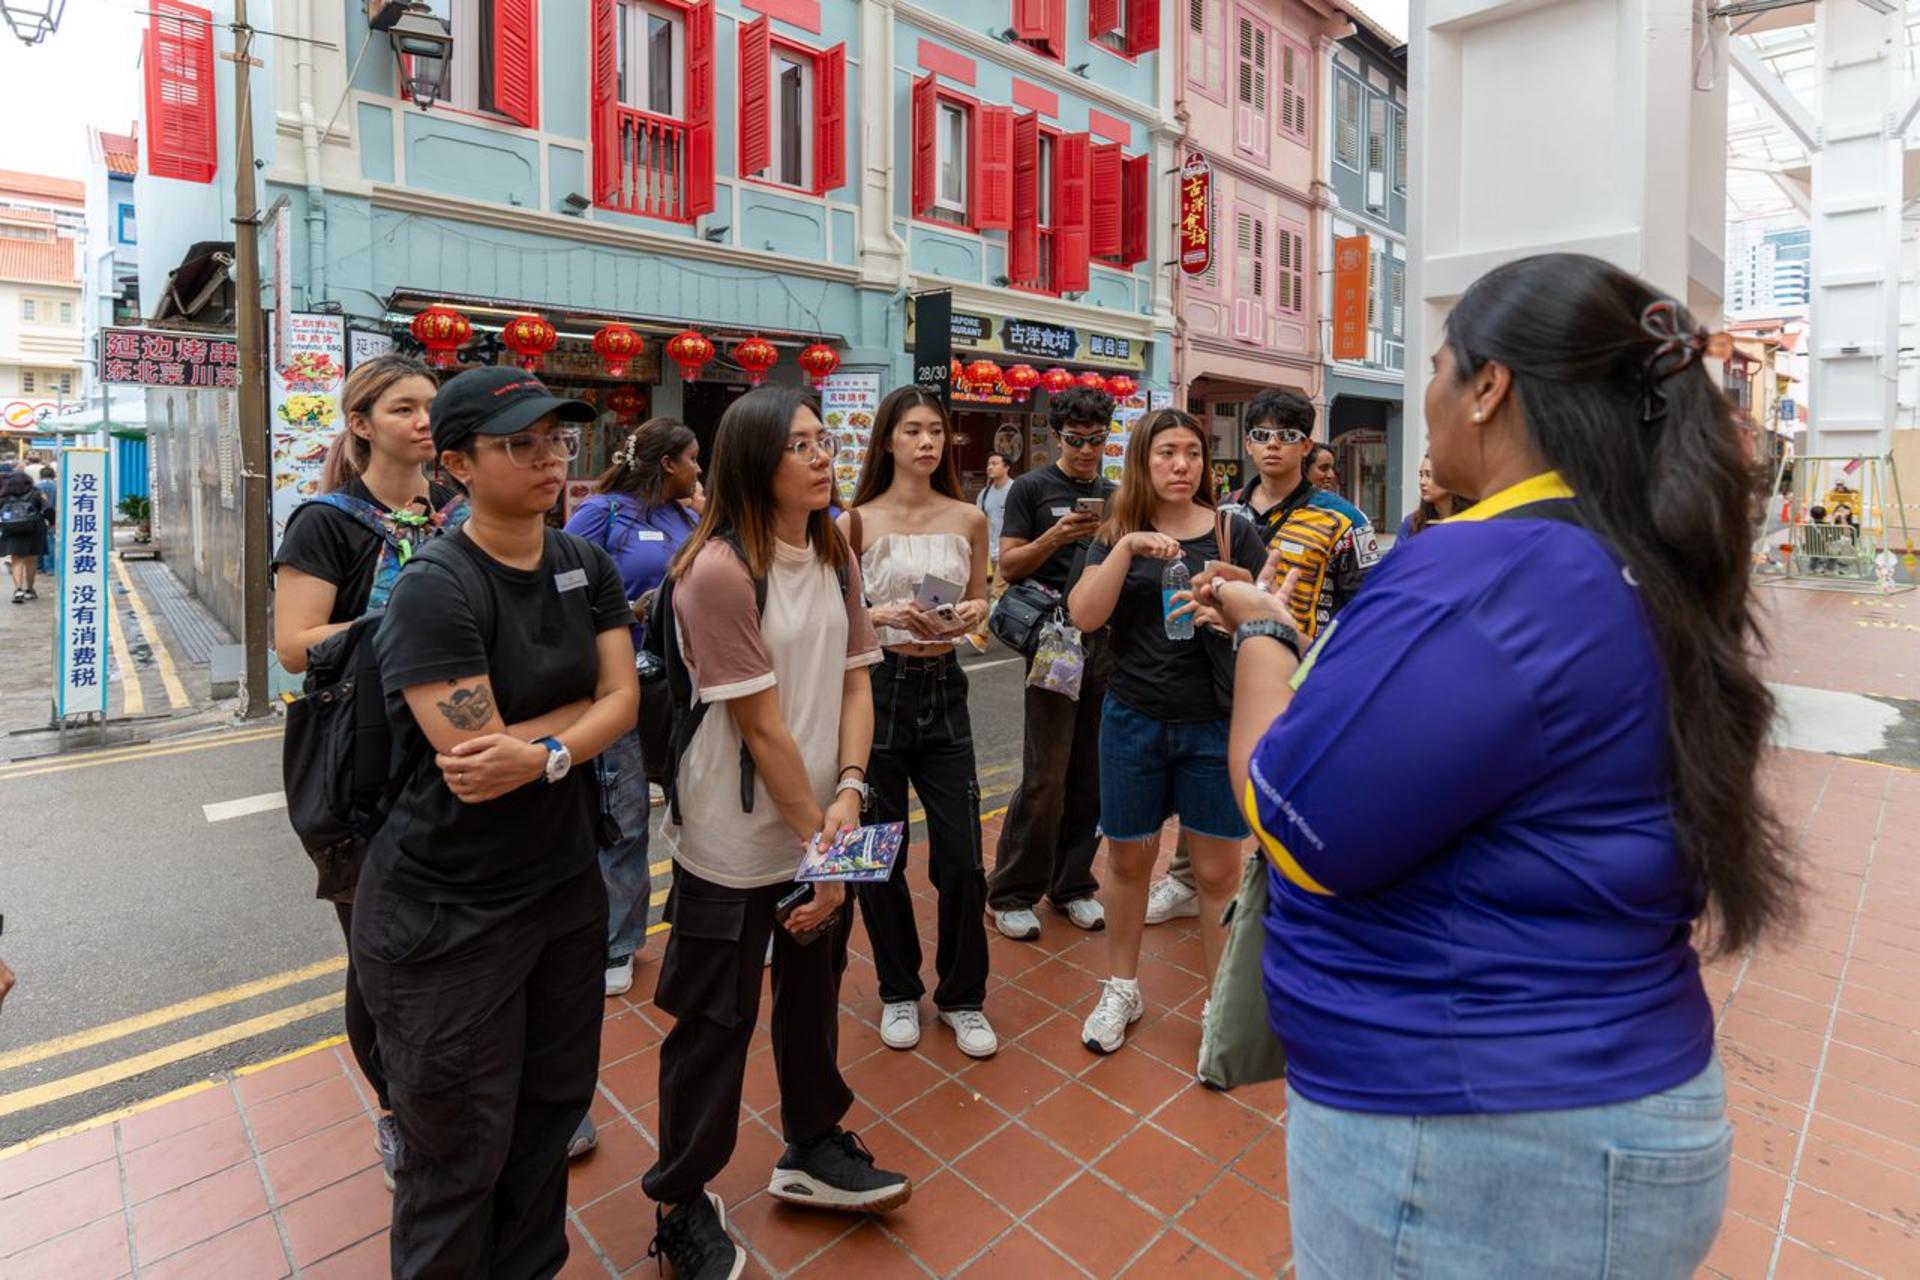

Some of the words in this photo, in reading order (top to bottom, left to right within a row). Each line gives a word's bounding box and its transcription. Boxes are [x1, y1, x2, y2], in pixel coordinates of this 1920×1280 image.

[1183, 177, 1208, 246] 古洋食坊
[950, 325, 982, 337] AURANT
[1010, 324, 1070, 350] 古洋食坊
[106, 333, 238, 365] 延边烤串
[106, 359, 185, 385] 东北菜
[190, 364, 238, 388] 川菜
[918, 365, 947, 382] 28/30
[72, 473, 98, 575] 没有服务费
[71, 585, 98, 688] 没有消费税
